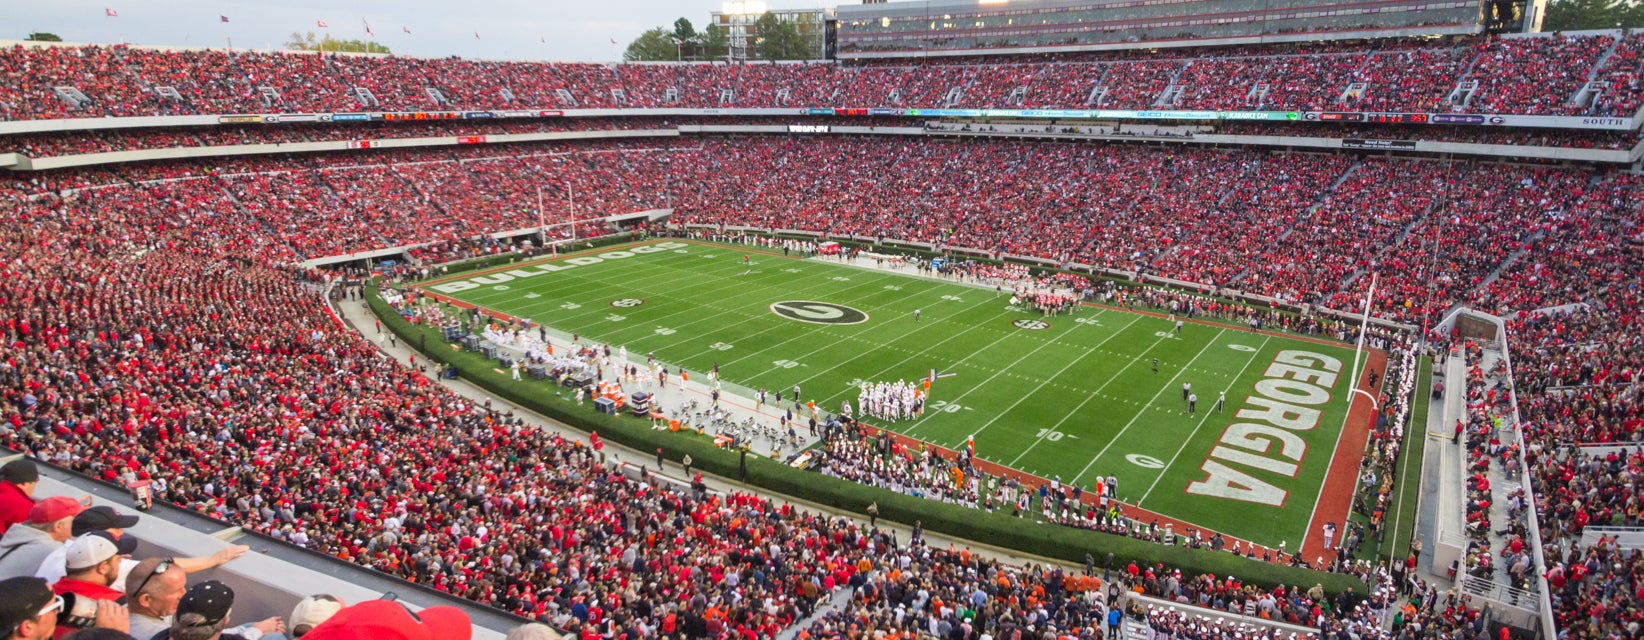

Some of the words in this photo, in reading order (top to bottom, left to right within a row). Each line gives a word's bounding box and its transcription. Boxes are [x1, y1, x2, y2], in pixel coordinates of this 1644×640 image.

[430, 242, 689, 293] BULLDOGS
[709, 342, 734, 351] 50
[773, 359, 799, 369] 40
[928, 400, 962, 413] 20
[1036, 428, 1065, 441] 10
[1185, 350, 1344, 507] GEORGIA
[1125, 454, 1165, 468] G
